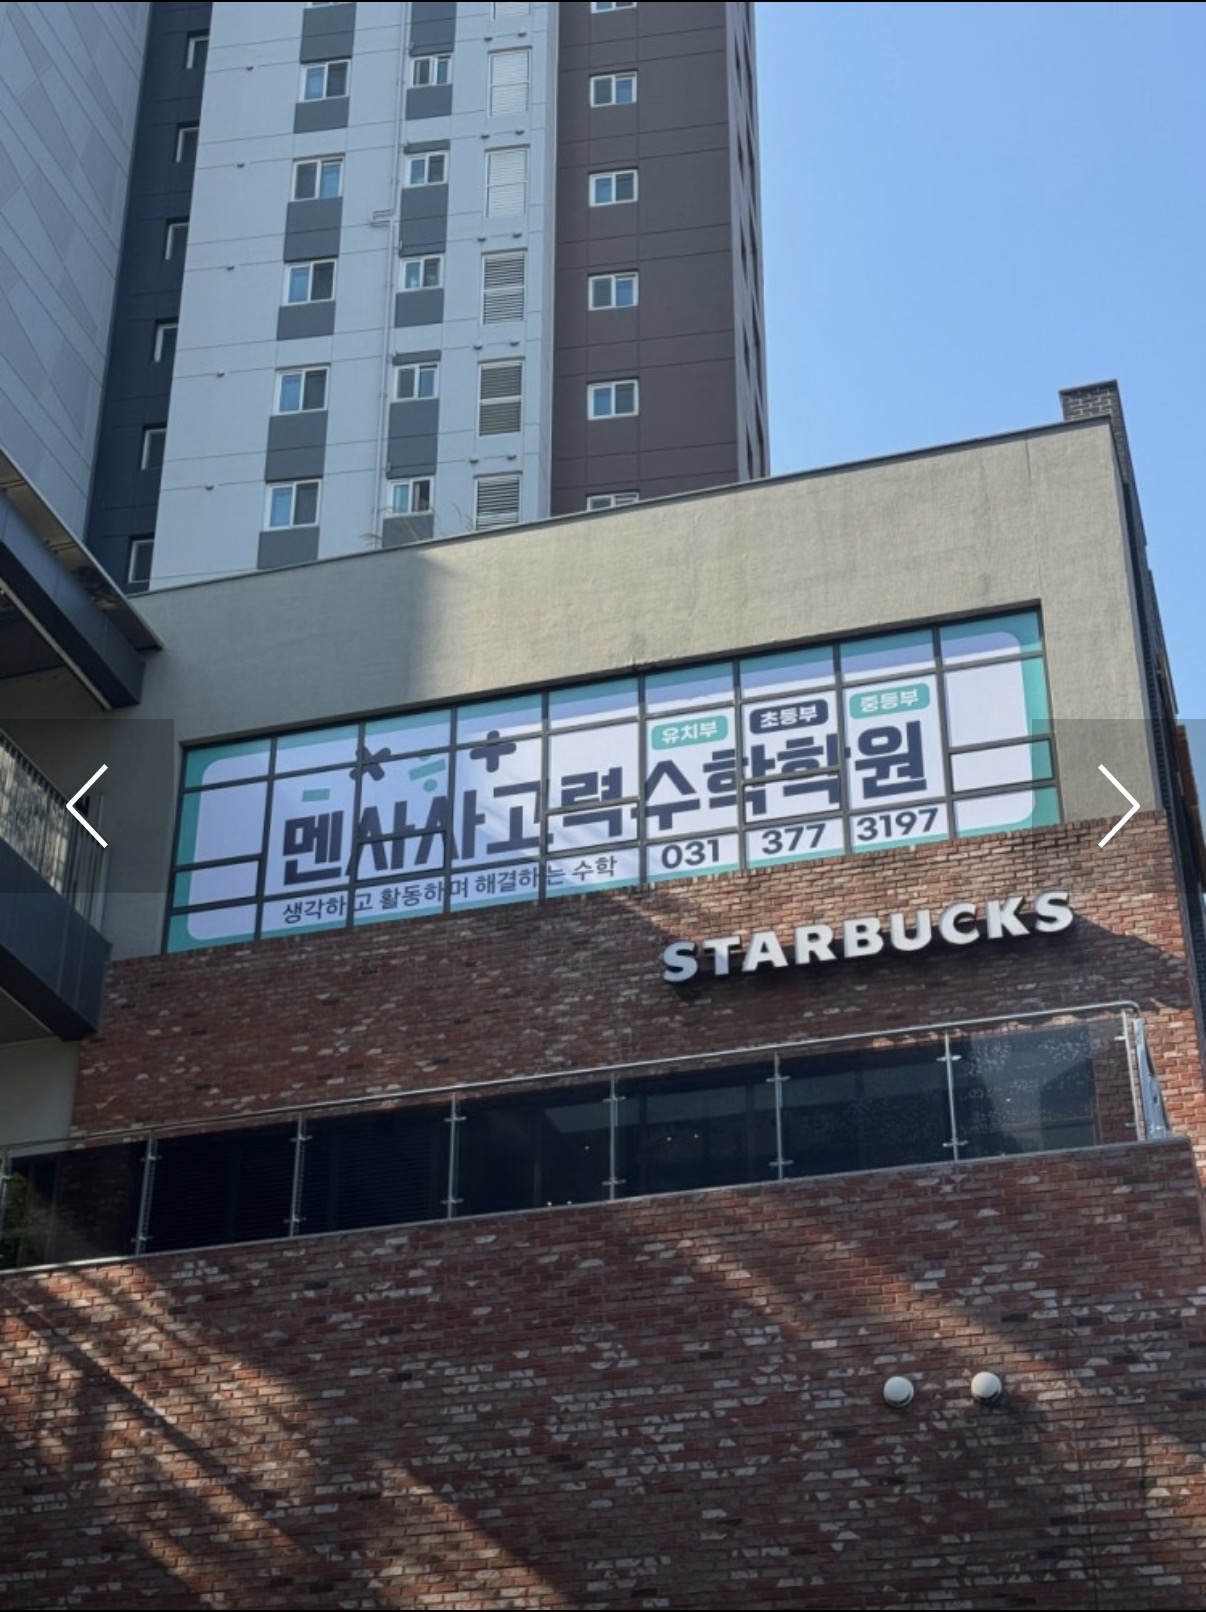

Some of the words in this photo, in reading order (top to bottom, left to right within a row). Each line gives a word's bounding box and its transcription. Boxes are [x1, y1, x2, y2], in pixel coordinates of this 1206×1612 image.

[759, 704, 819, 729] 초등부
[860, 688, 920, 713] 중등부
[661, 720, 719, 744] 유치부
[660, 838, 721, 870] 031
[761, 823, 827, 855] 377
[856, 807, 939, 842] 3197
[282, 892, 374, 925] 생각하고
[380, 875, 469, 910] 활동하며
[474, 865, 566, 896] 해결하는
[572, 854, 618, 880] 수학
[662, 891, 1075, 983] STARBUCKS
